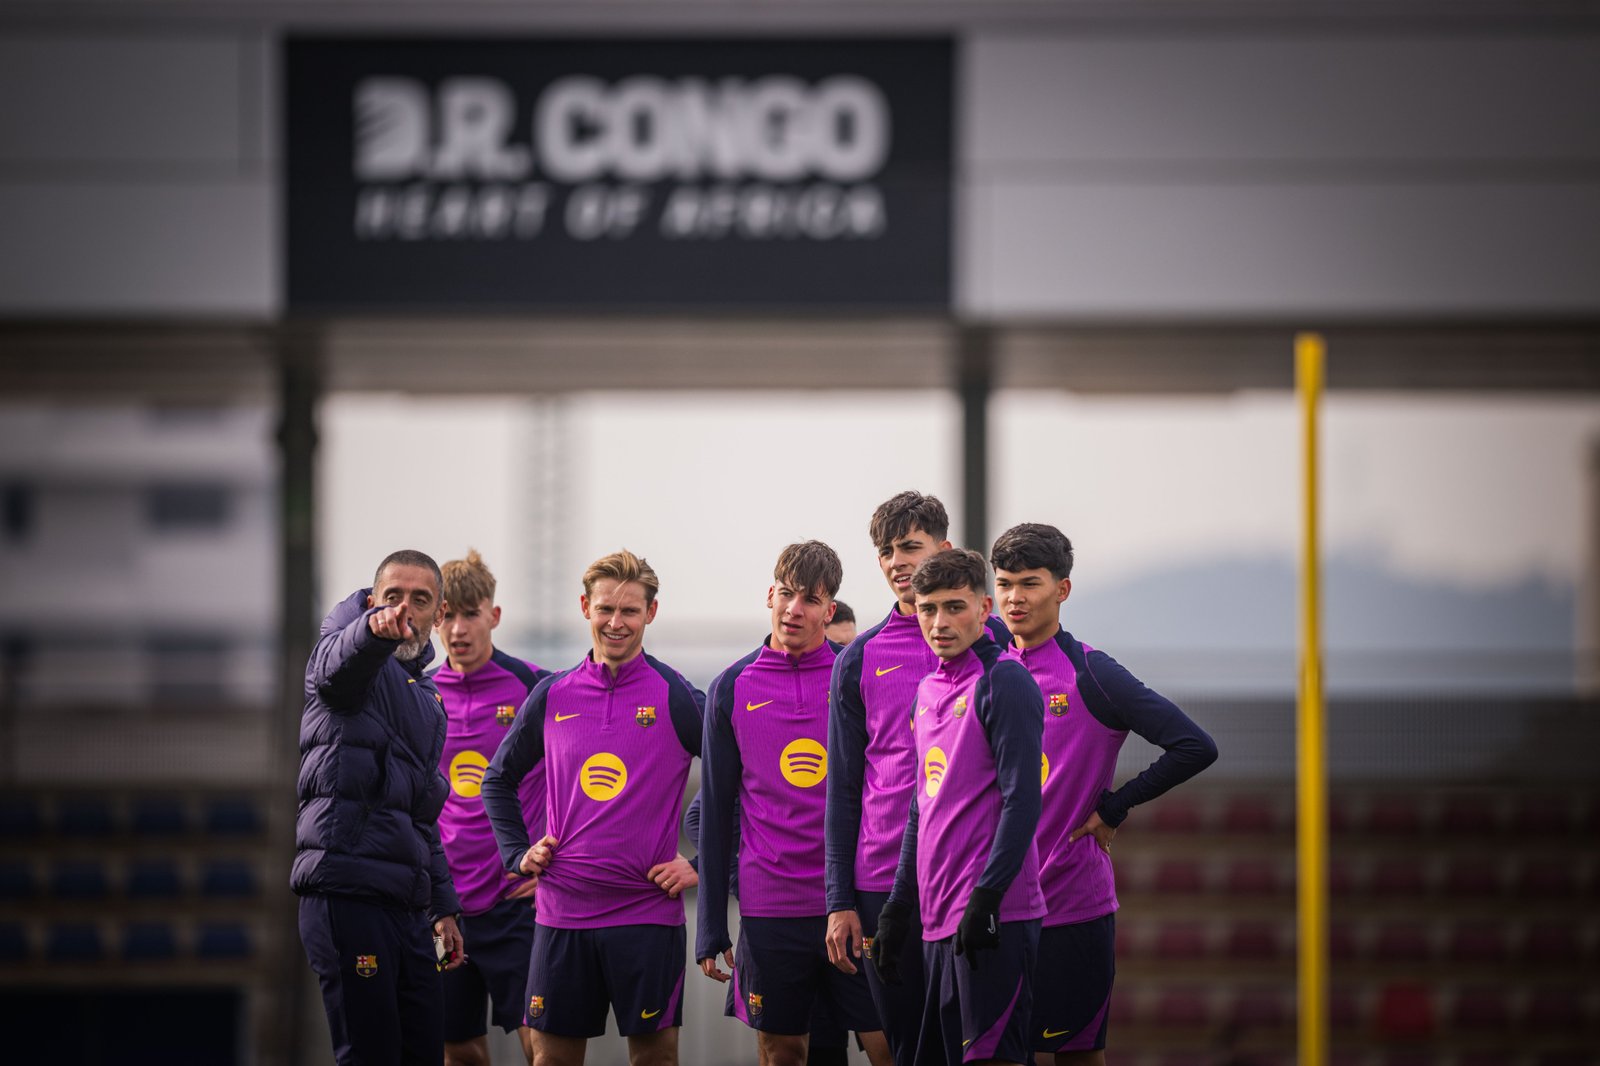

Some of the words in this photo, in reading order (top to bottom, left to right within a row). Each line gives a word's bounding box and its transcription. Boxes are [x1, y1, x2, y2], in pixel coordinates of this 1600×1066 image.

[534, 74, 890, 183] CONGO
[355, 183, 549, 240] HEART
[564, 183, 652, 240] OF
[660, 183, 887, 240] AFRICA
